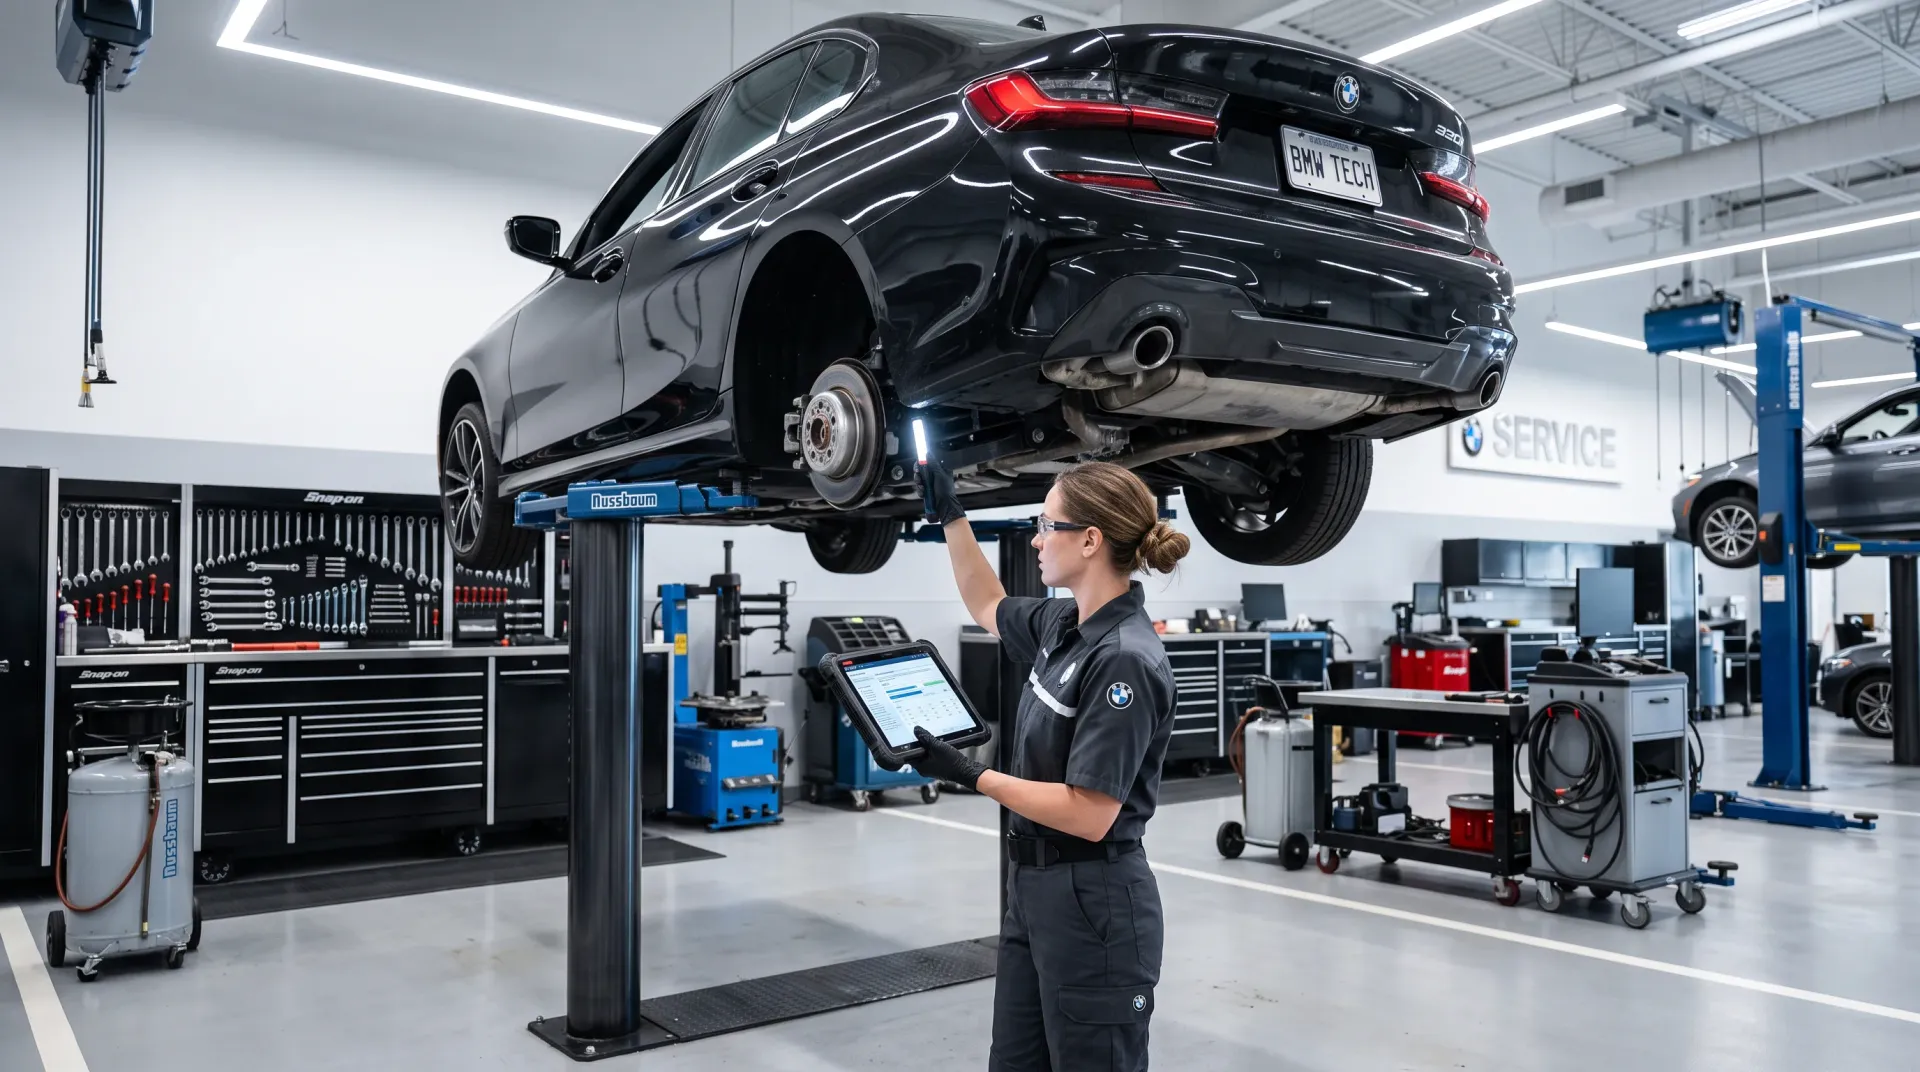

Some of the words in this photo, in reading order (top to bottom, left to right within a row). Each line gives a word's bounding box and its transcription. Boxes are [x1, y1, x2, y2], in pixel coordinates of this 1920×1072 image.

[1290, 145, 1325, 179] BMW
[1329, 153, 1375, 191] TECH
[1492, 412, 1617, 469] SERVICE
[303, 491, 365, 506] Snap-on
[591, 491, 658, 510] Nussbaum
[78, 670, 130, 680] Snap-on
[215, 666, 263, 676] Snap-on
[162, 798, 179, 879] Nussbaum
